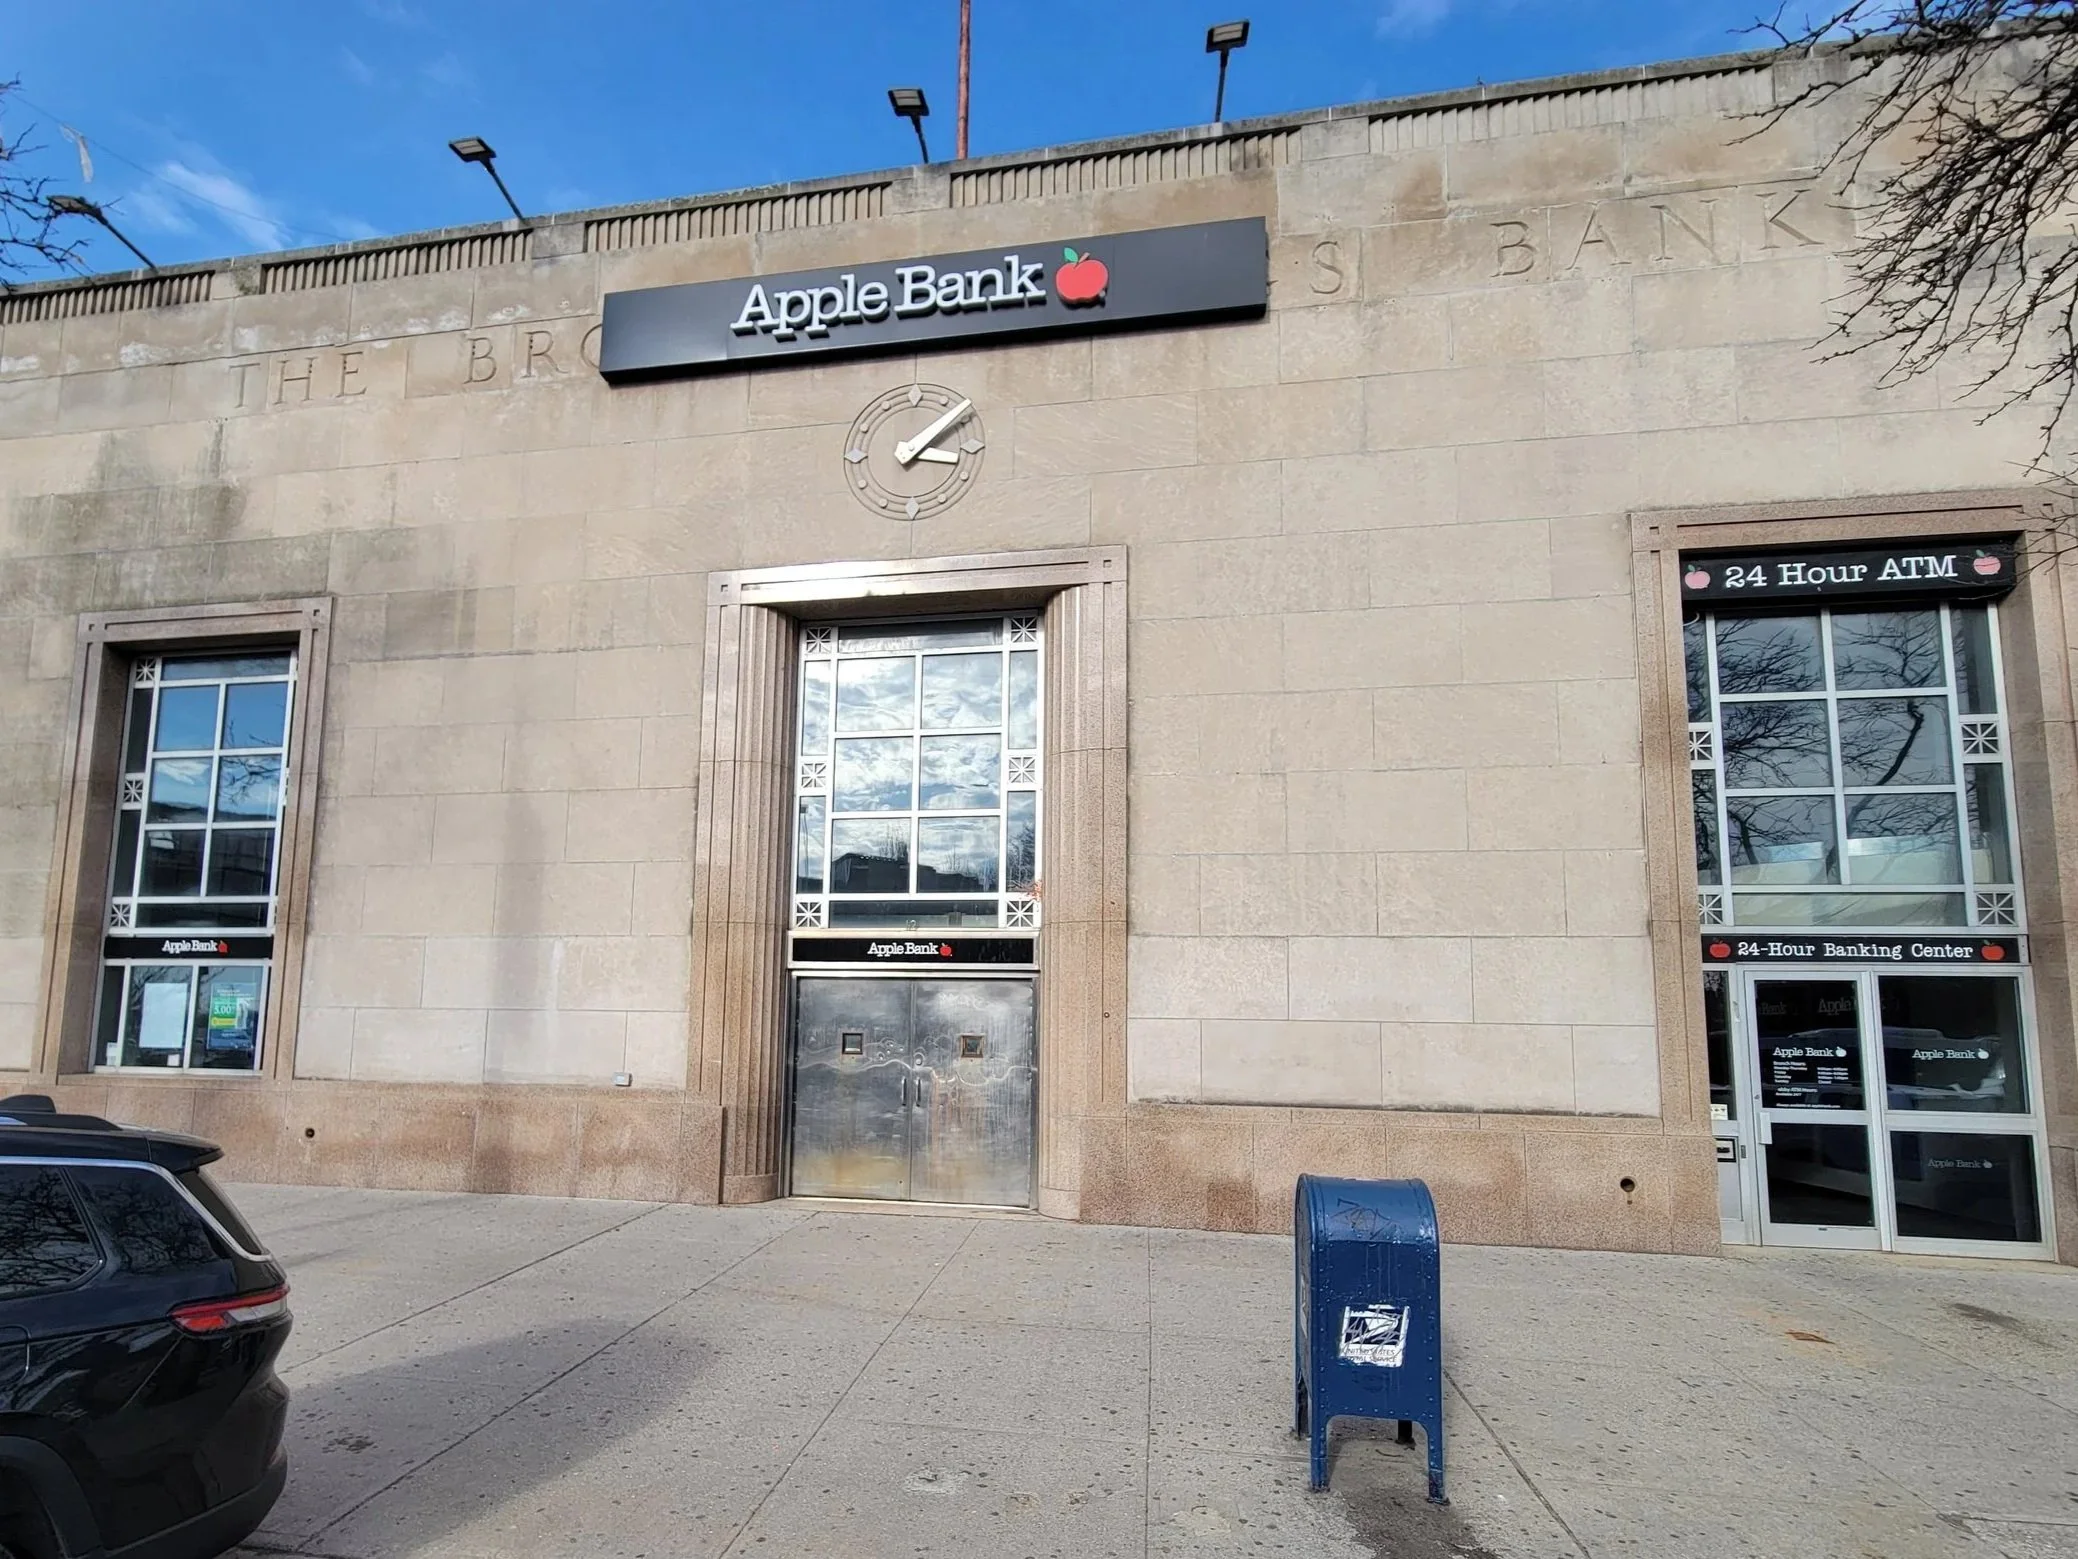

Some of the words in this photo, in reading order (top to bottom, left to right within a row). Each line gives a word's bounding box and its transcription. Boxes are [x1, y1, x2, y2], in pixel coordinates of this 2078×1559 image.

[229, 351, 368, 408] THE
[1489, 189, 1825, 279] BANK
[730, 273, 890, 340] Apple
[894, 254, 1048, 314] Bank
[1725, 565, 1768, 589] 24
[1777, 562, 1868, 586] Hour
[1877, 554, 1959, 582] ATM
[162, 939, 191, 954] Apple
[191, 939, 218, 952] Bank
[867, 942, 904, 957] Apple
[904, 942, 939, 955] Bank
[1737, 940, 1816, 957] 24-Hour
[1824, 941, 1903, 961] Banking
[1911, 942, 1974, 959] Center
[1772, 1046, 1804, 1058] Apple
[1804, 1047, 1834, 1057] Bank
[1912, 1049, 1944, 1060] Apple
[1945, 1049, 1976, 1059] Bank
